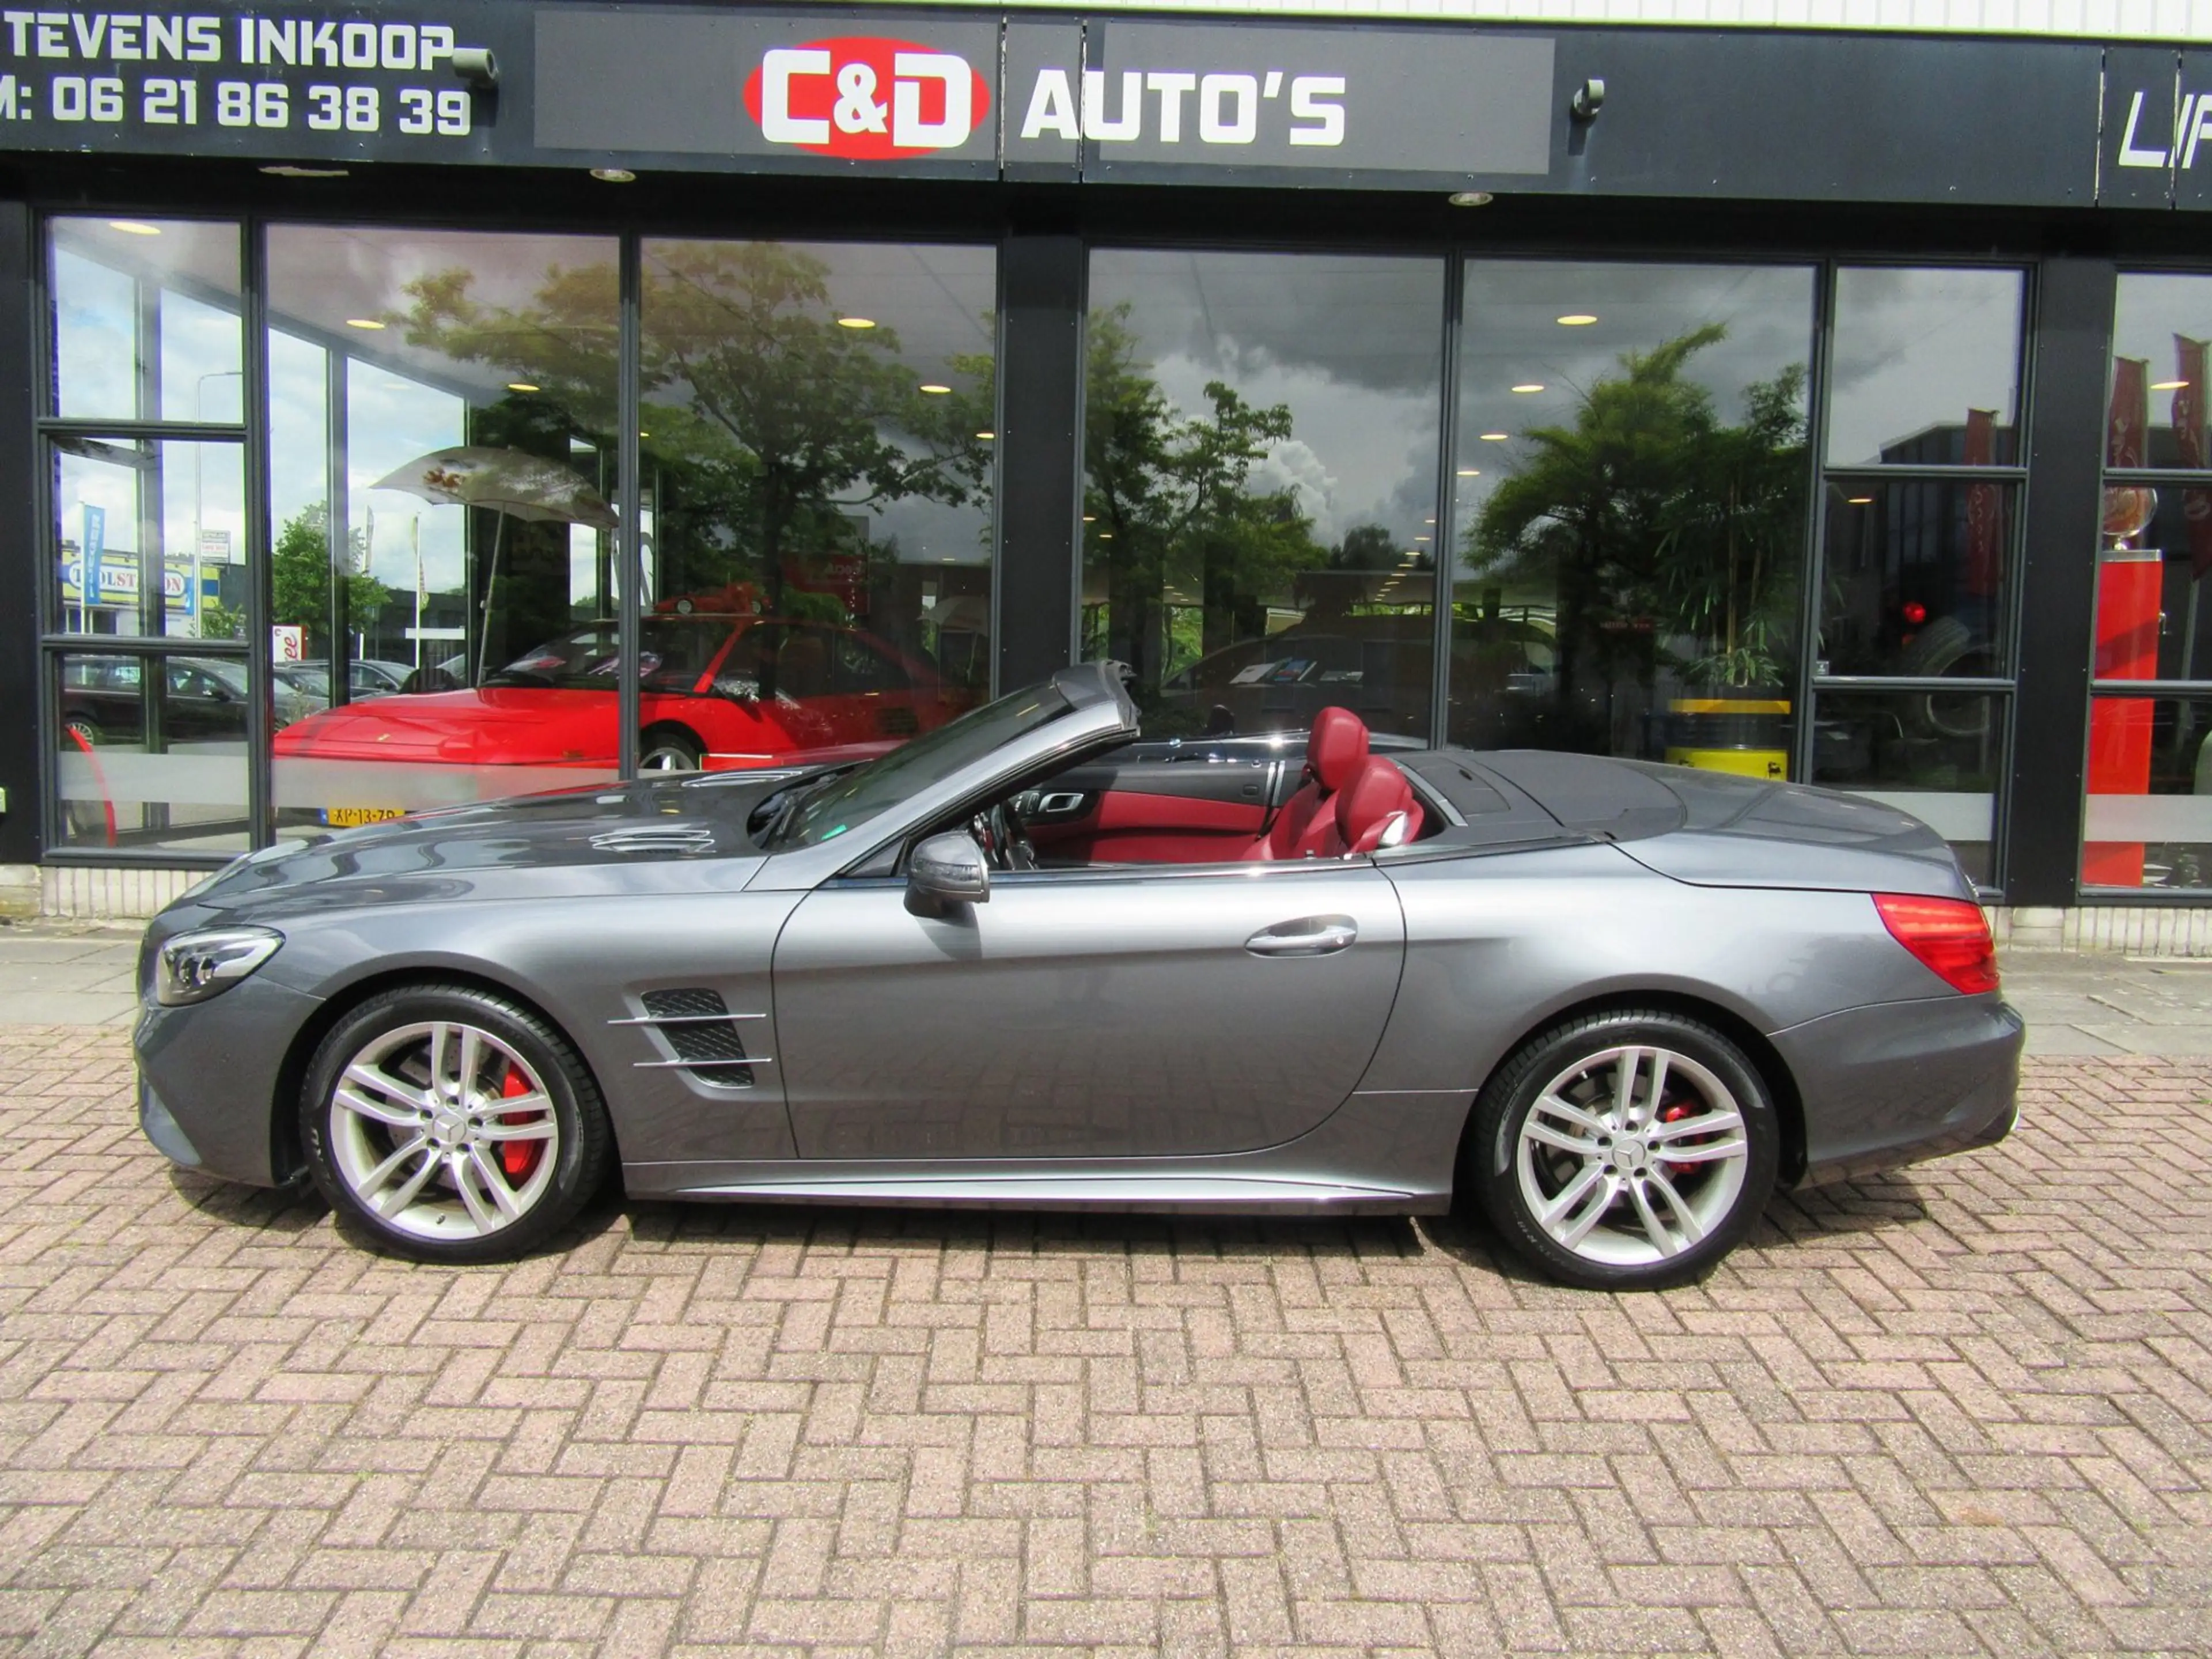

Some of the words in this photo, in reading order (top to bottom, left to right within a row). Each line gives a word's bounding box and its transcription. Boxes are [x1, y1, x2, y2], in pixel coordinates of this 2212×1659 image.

[5, 12, 220, 61] TEVENS
[241, 18, 453, 70] INKOOP
[53, 77, 123, 121] 06
[144, 79, 197, 124] 21
[218, 82, 288, 127] 86
[309, 86, 379, 131] 38
[400, 89, 471, 135] 39
[762, 49, 972, 148] C&D
[1021, 69, 1346, 146] AUTO'S
